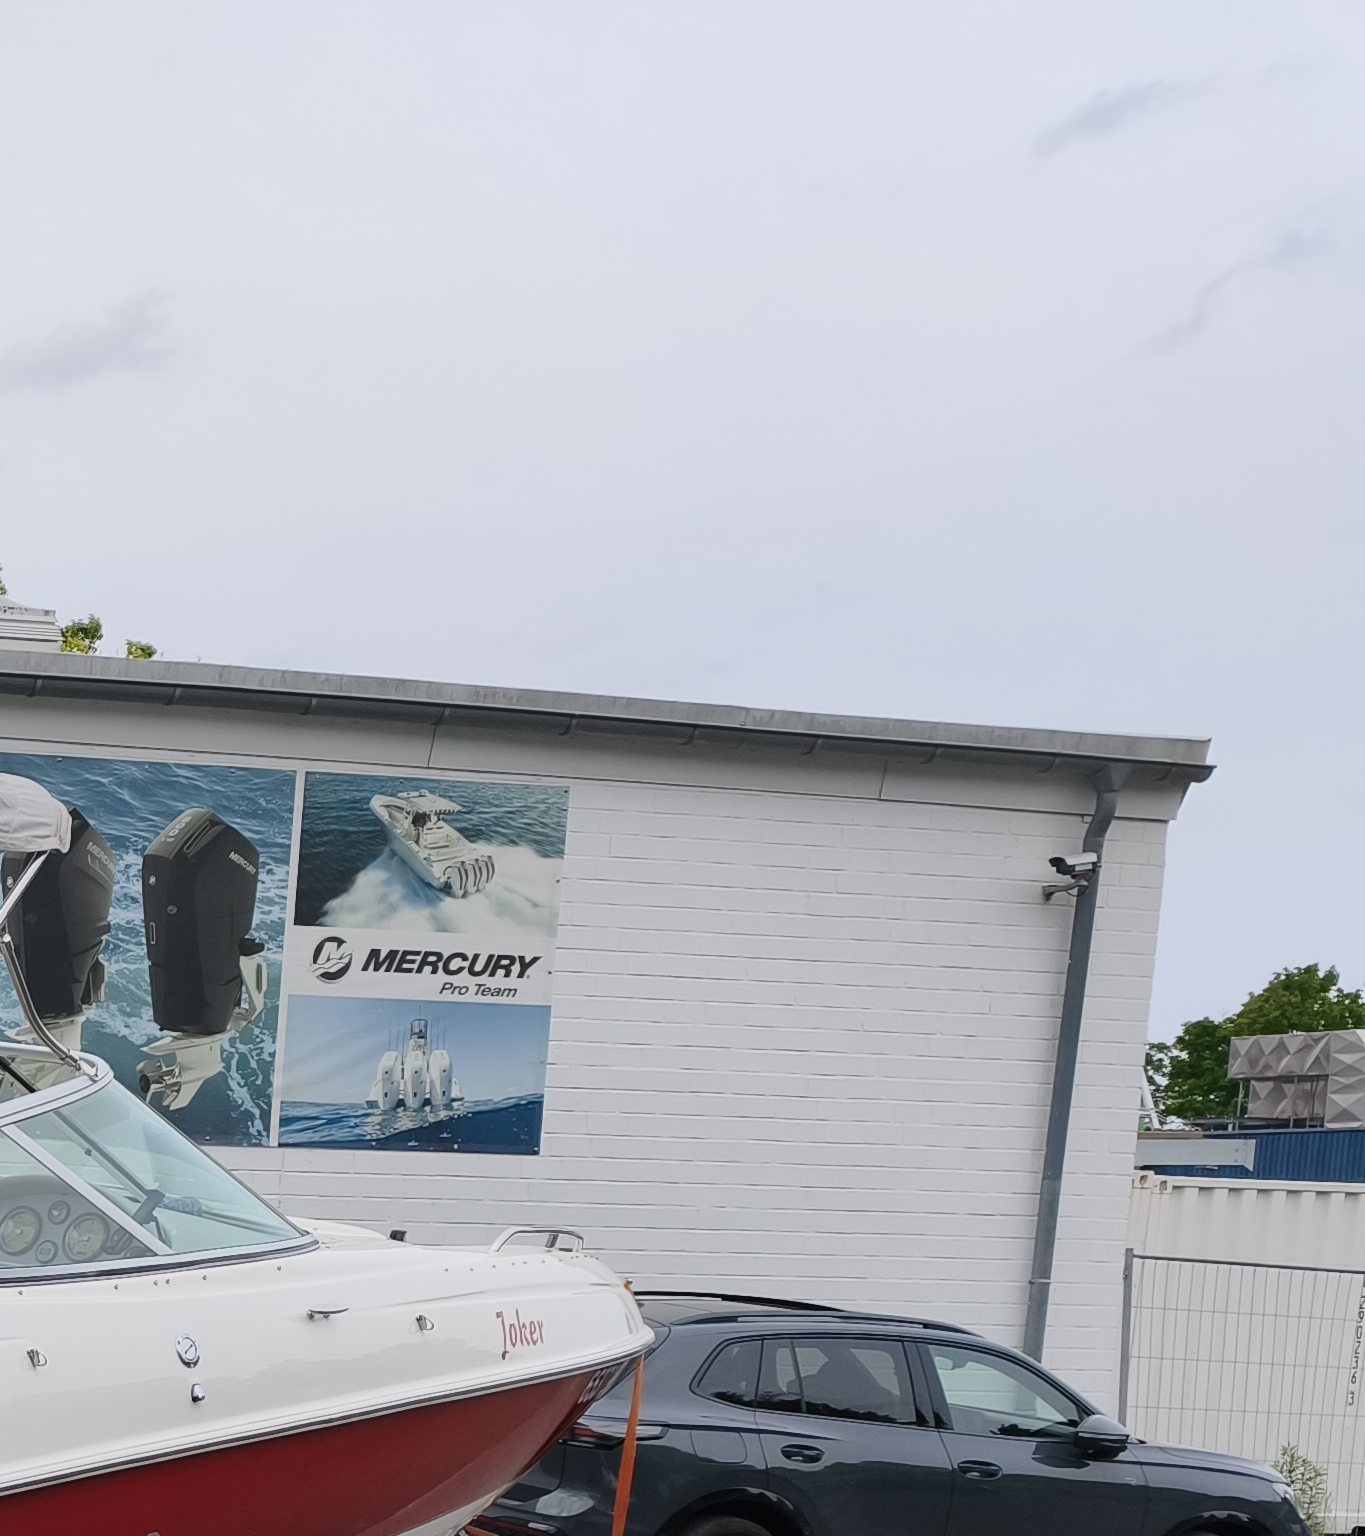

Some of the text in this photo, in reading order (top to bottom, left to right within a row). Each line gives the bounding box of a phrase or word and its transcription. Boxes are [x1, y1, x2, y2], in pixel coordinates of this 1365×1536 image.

[360, 948, 544, 979] MERCURY
[438, 982, 518, 998] Pro Team
[495, 1308, 545, 1361] Joker
